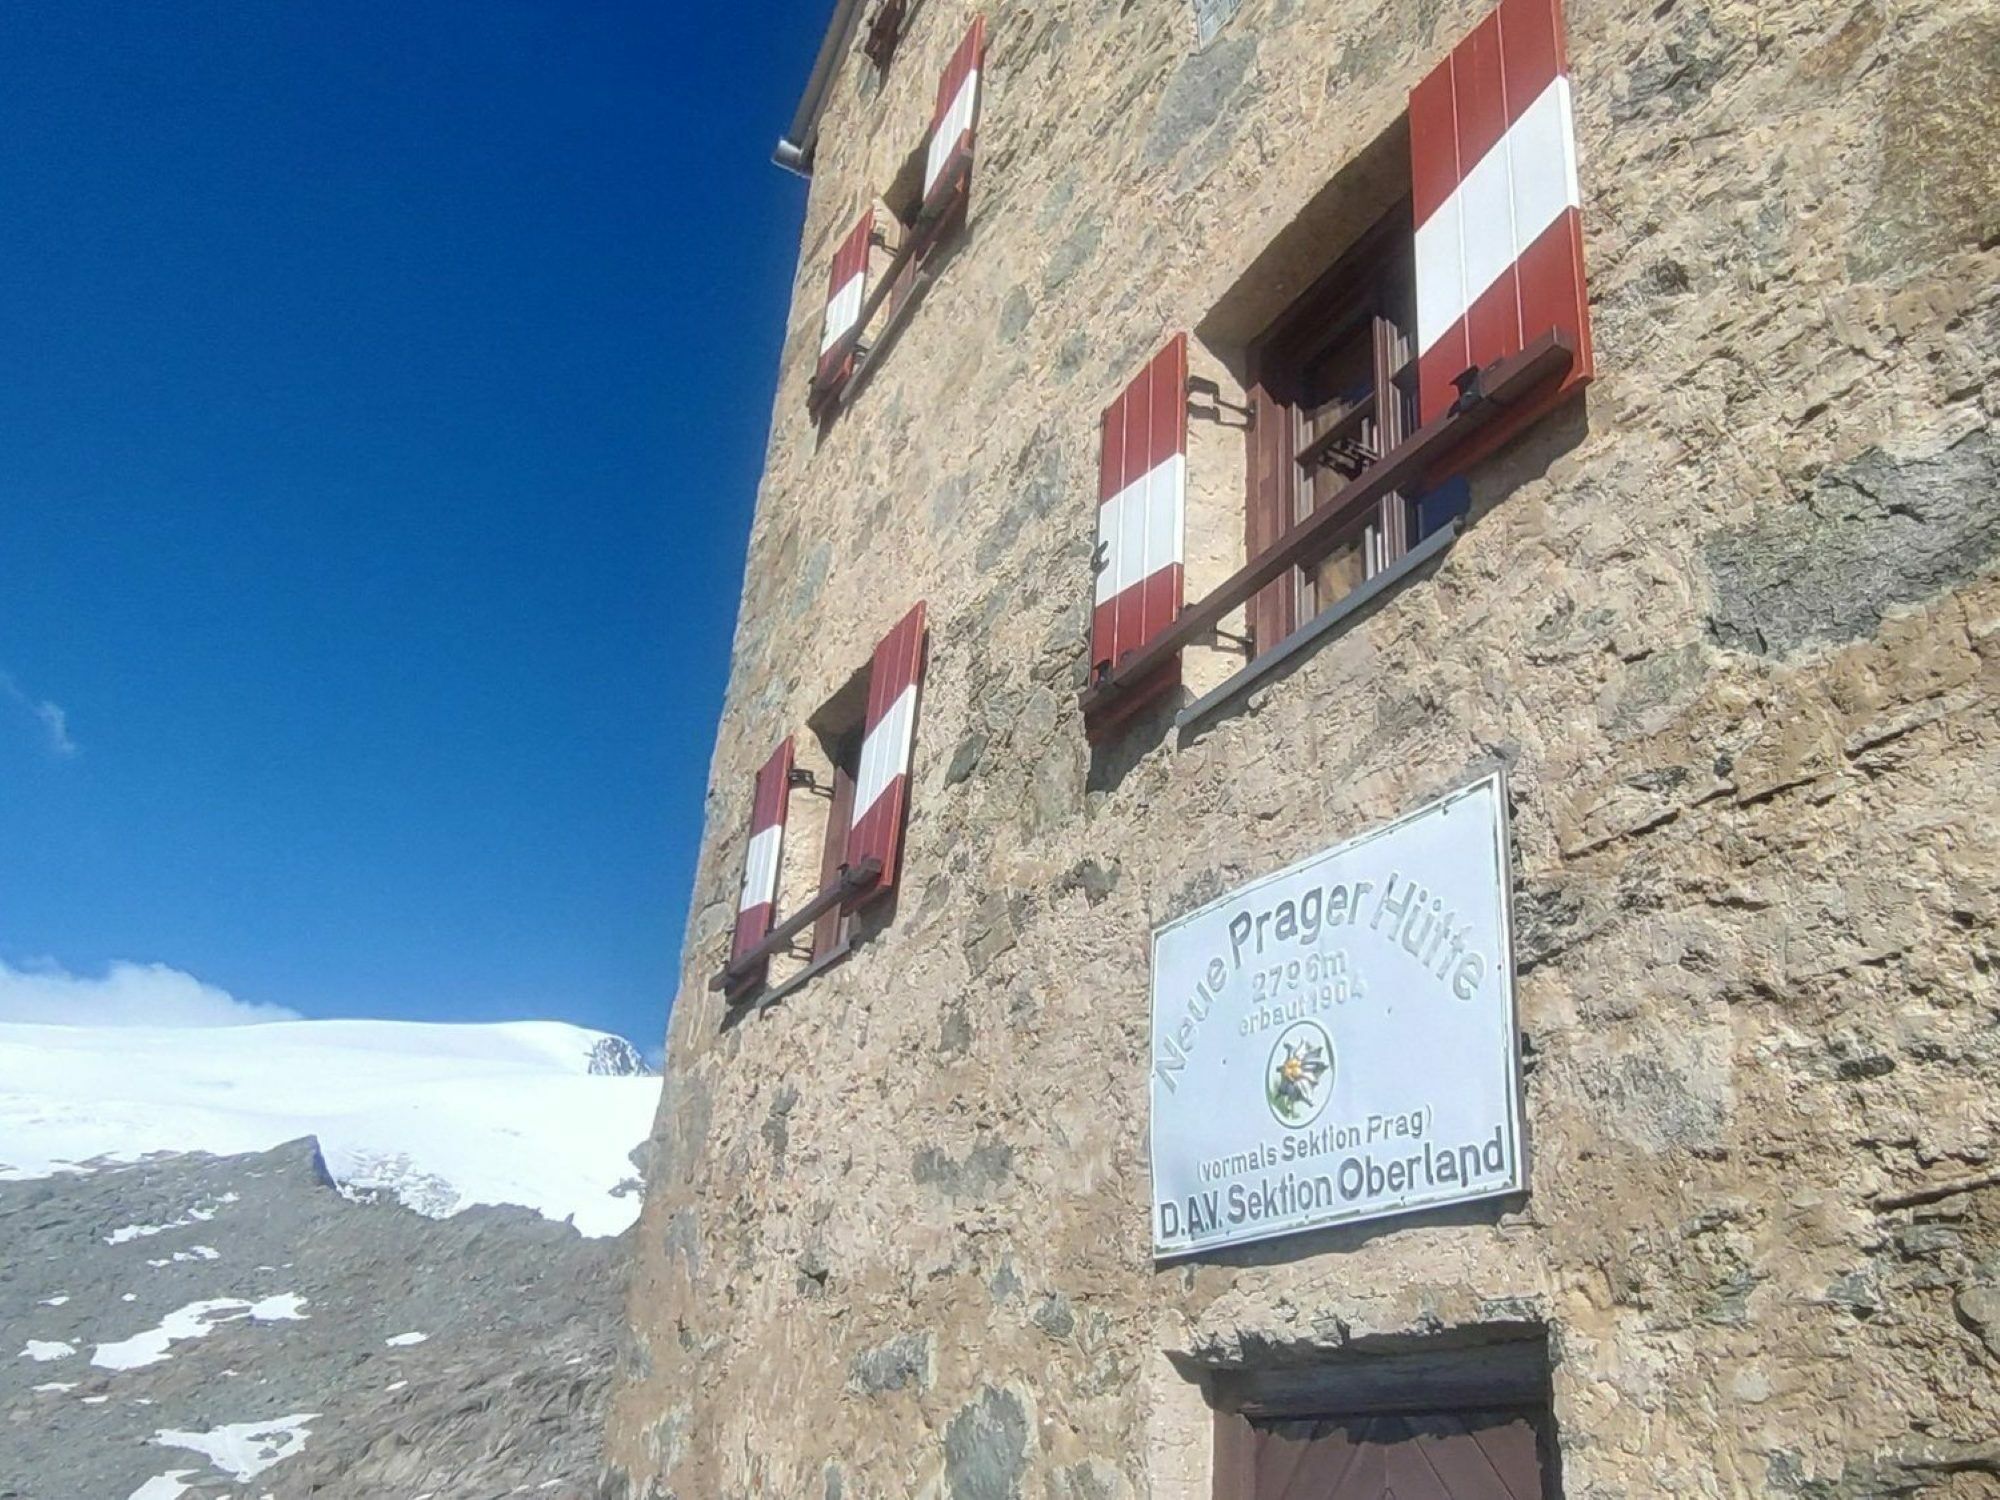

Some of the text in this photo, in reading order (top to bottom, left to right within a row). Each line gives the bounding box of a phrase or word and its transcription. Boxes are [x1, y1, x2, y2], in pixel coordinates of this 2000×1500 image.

[1229, 881, 1373, 970] Prager
[1370, 872, 1487, 1001] Hütte
[1227, 1172, 1333, 1225] Sektion
[1337, 1125, 1505, 1201] Oberland
[1281, 1124, 1361, 1162] Sektion
[1366, 1103, 1433, 1144] Prag)
